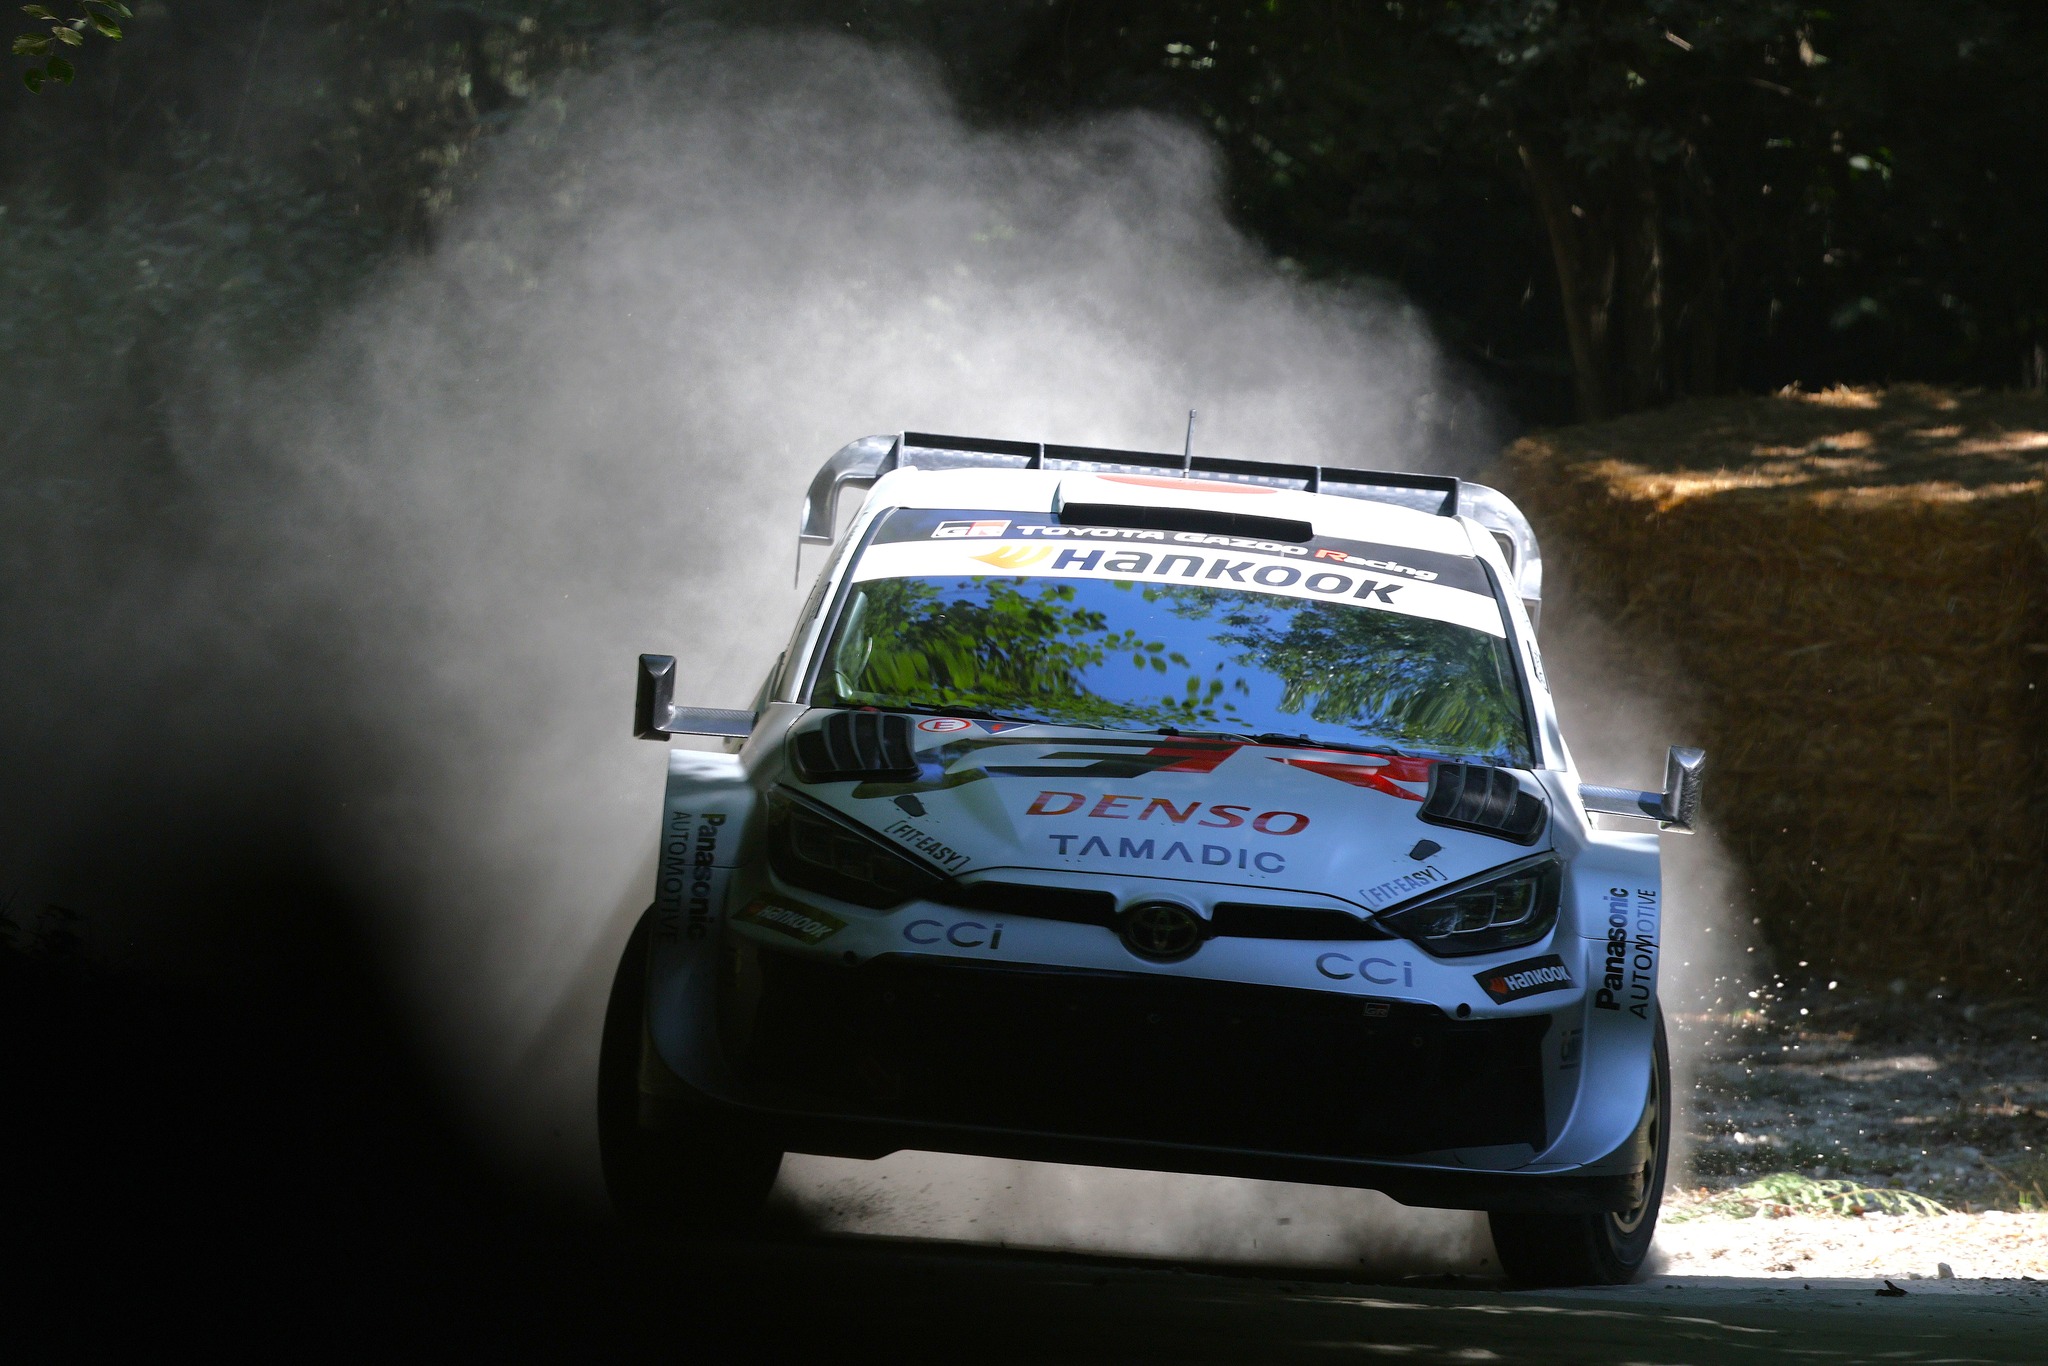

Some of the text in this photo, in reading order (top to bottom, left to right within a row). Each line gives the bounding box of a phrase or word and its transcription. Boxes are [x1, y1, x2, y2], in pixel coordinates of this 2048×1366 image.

[933, 522, 1439, 581] GR TOYOTA GAZOO Racing
[1025, 790, 1311, 836] DENSO
[1049, 834, 1287, 874] TAMADIC
[661, 811, 692, 944] AUTOMOTIVE
[687, 813, 726, 941] Panasonic
[1594, 887, 1629, 1011] Panasonic
[1629, 889, 1657, 1020] AUTOMOTIVE
